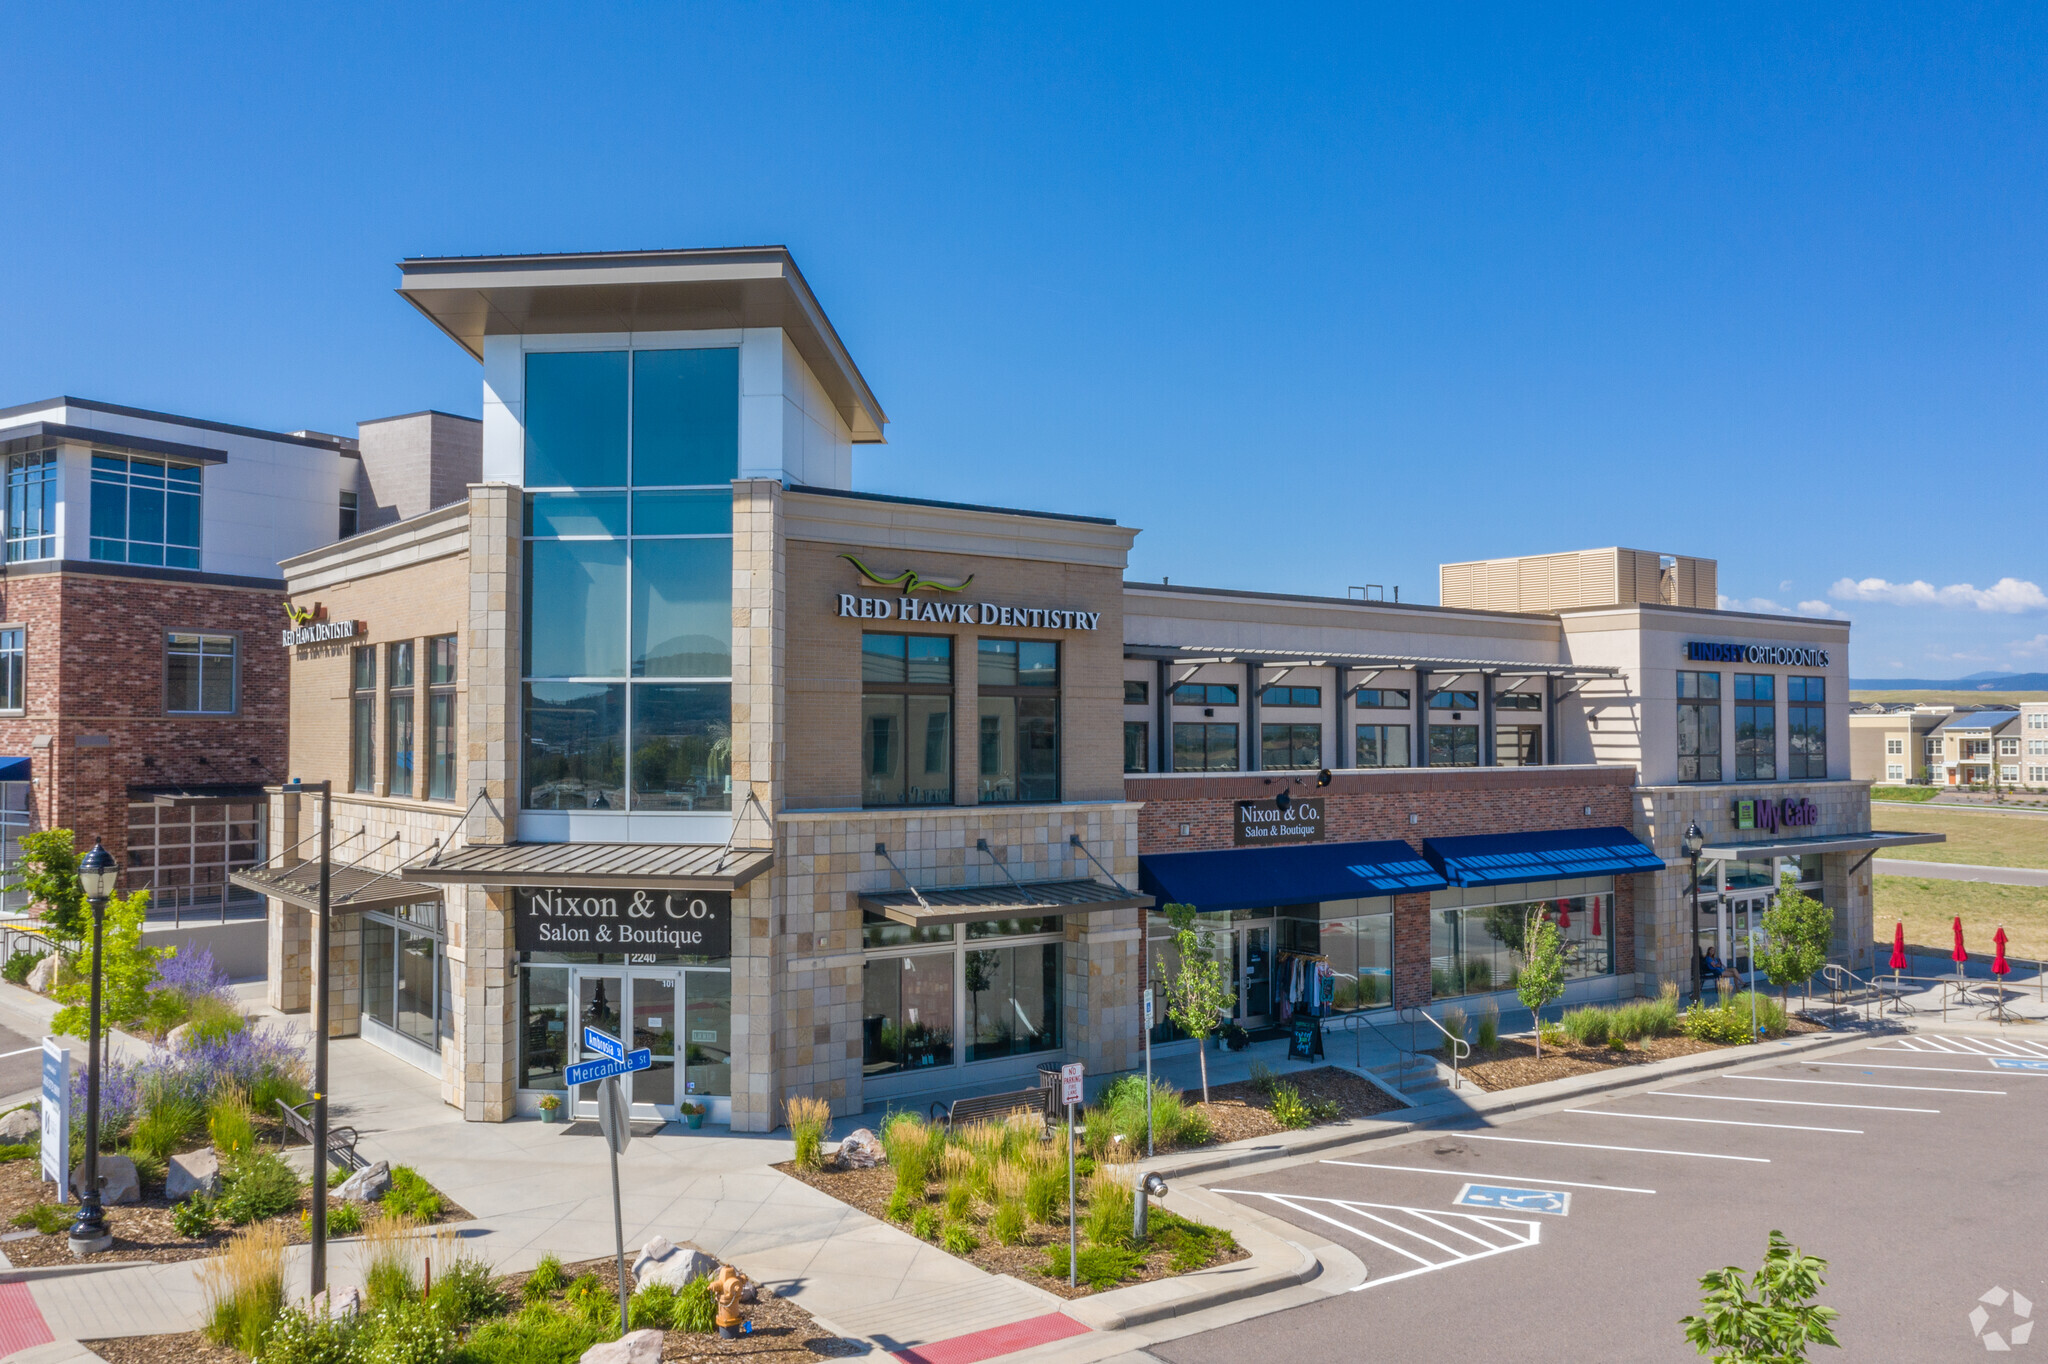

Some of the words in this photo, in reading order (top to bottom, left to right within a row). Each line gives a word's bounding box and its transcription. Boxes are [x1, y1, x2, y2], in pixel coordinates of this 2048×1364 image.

[838, 593, 891, 619] RED
[899, 597, 975, 624] HAWK
[978, 603, 1100, 630] DENTISTRY
[282, 630, 295, 647] RED
[296, 627, 316, 644] HAWK
[315, 620, 353, 641] DENTISTRY
[1690, 641, 1745, 662] LINDSEY
[1748, 645, 1829, 667] ORTHODONTICS
[1240, 805, 1280, 822] Nixon
[1284, 806, 1296, 821] &
[1299, 803, 1320, 820] Co.
[1757, 800, 1779, 834] My
[1784, 798, 1817, 826] Cafe
[1245, 825, 1268, 837] Salon
[1270, 825, 1278, 836] &
[1280, 823, 1315, 837] Boutique
[529, 888, 618, 917] Nixon
[627, 890, 655, 918] &
[665, 894, 716, 919] Co.
[539, 922, 590, 942] Salon
[595, 924, 613, 943] &
[618, 924, 702, 949] Boutique
[631, 953, 656, 963] 2240
[662, 980, 674, 988] 101
[588, 1032, 614, 1056] Ambrosia
[639, 1054, 647, 1065] St
[1064, 1075, 1081, 1084] PARKING
